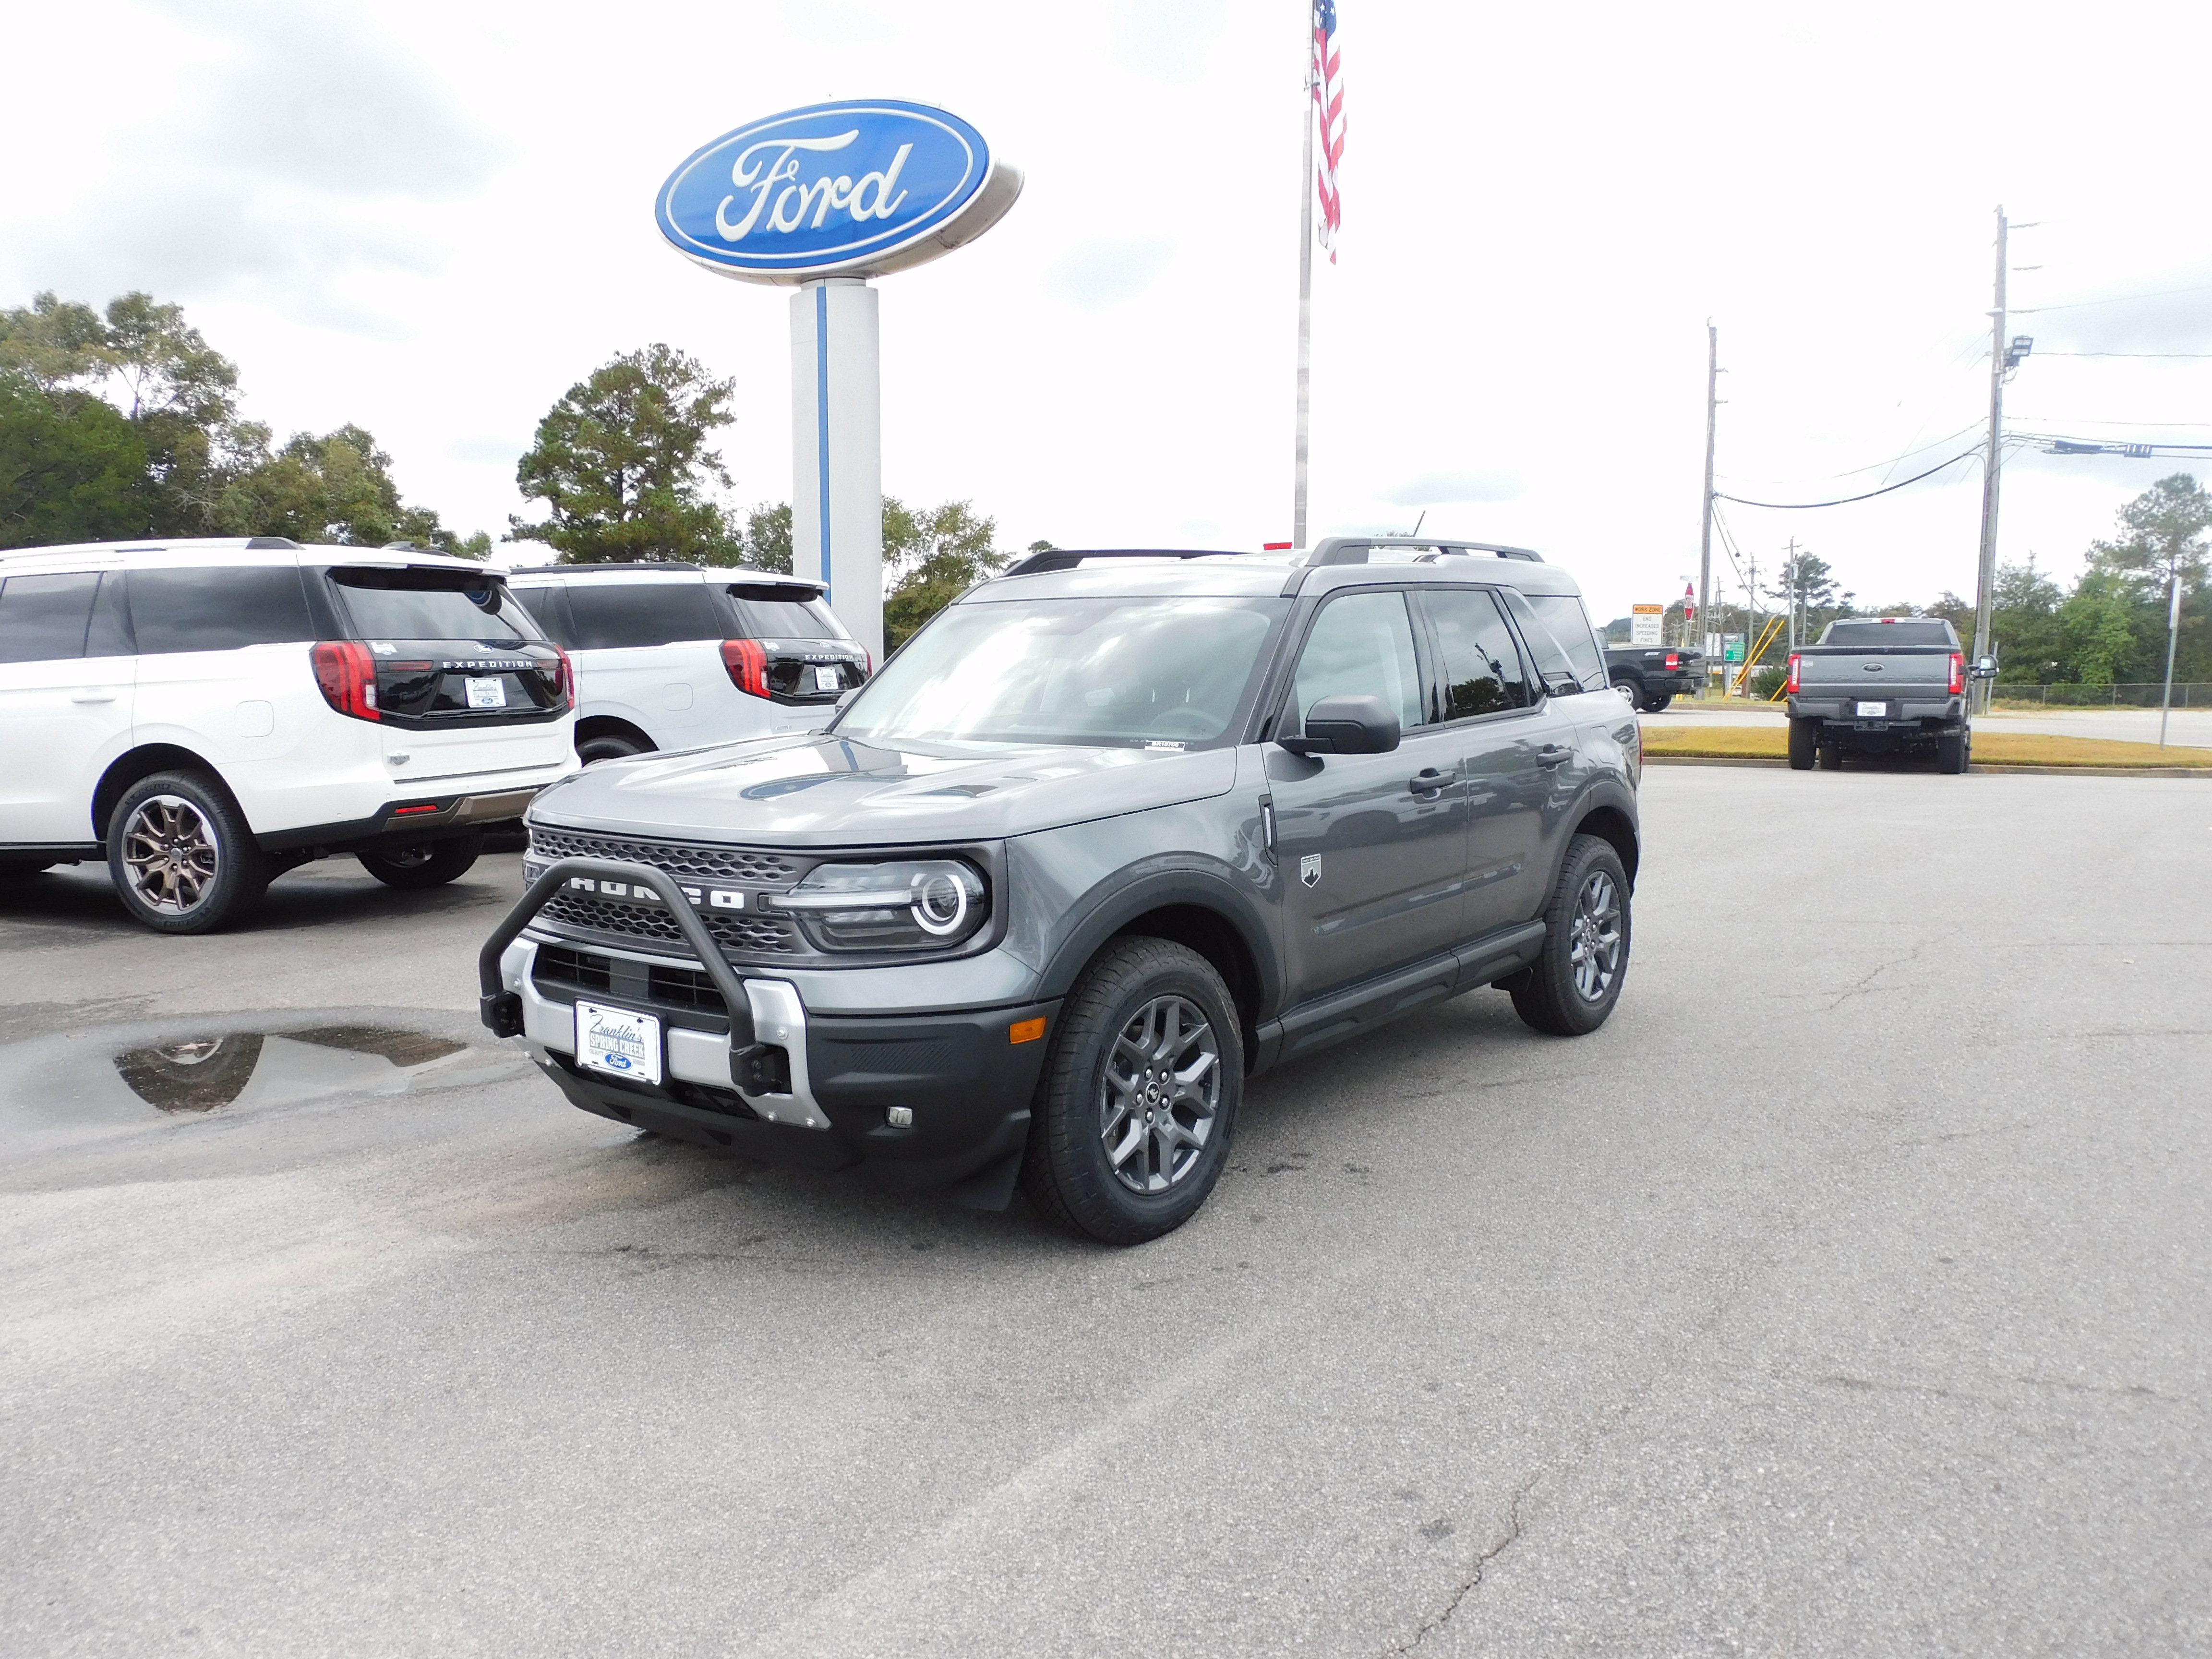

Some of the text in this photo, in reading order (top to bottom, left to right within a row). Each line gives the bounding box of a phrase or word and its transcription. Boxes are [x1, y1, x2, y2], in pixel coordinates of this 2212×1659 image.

[716, 129, 914, 242] Ford
[443, 661, 532, 669] EXPEDITION
[557, 876, 745, 909] RONCO
[589, 1014, 644, 1042] Franklin's
[590, 1033, 618, 1051] SPRING
[619, 1040, 644, 1058] CREEK
[609, 1054, 626, 1068] Ford
